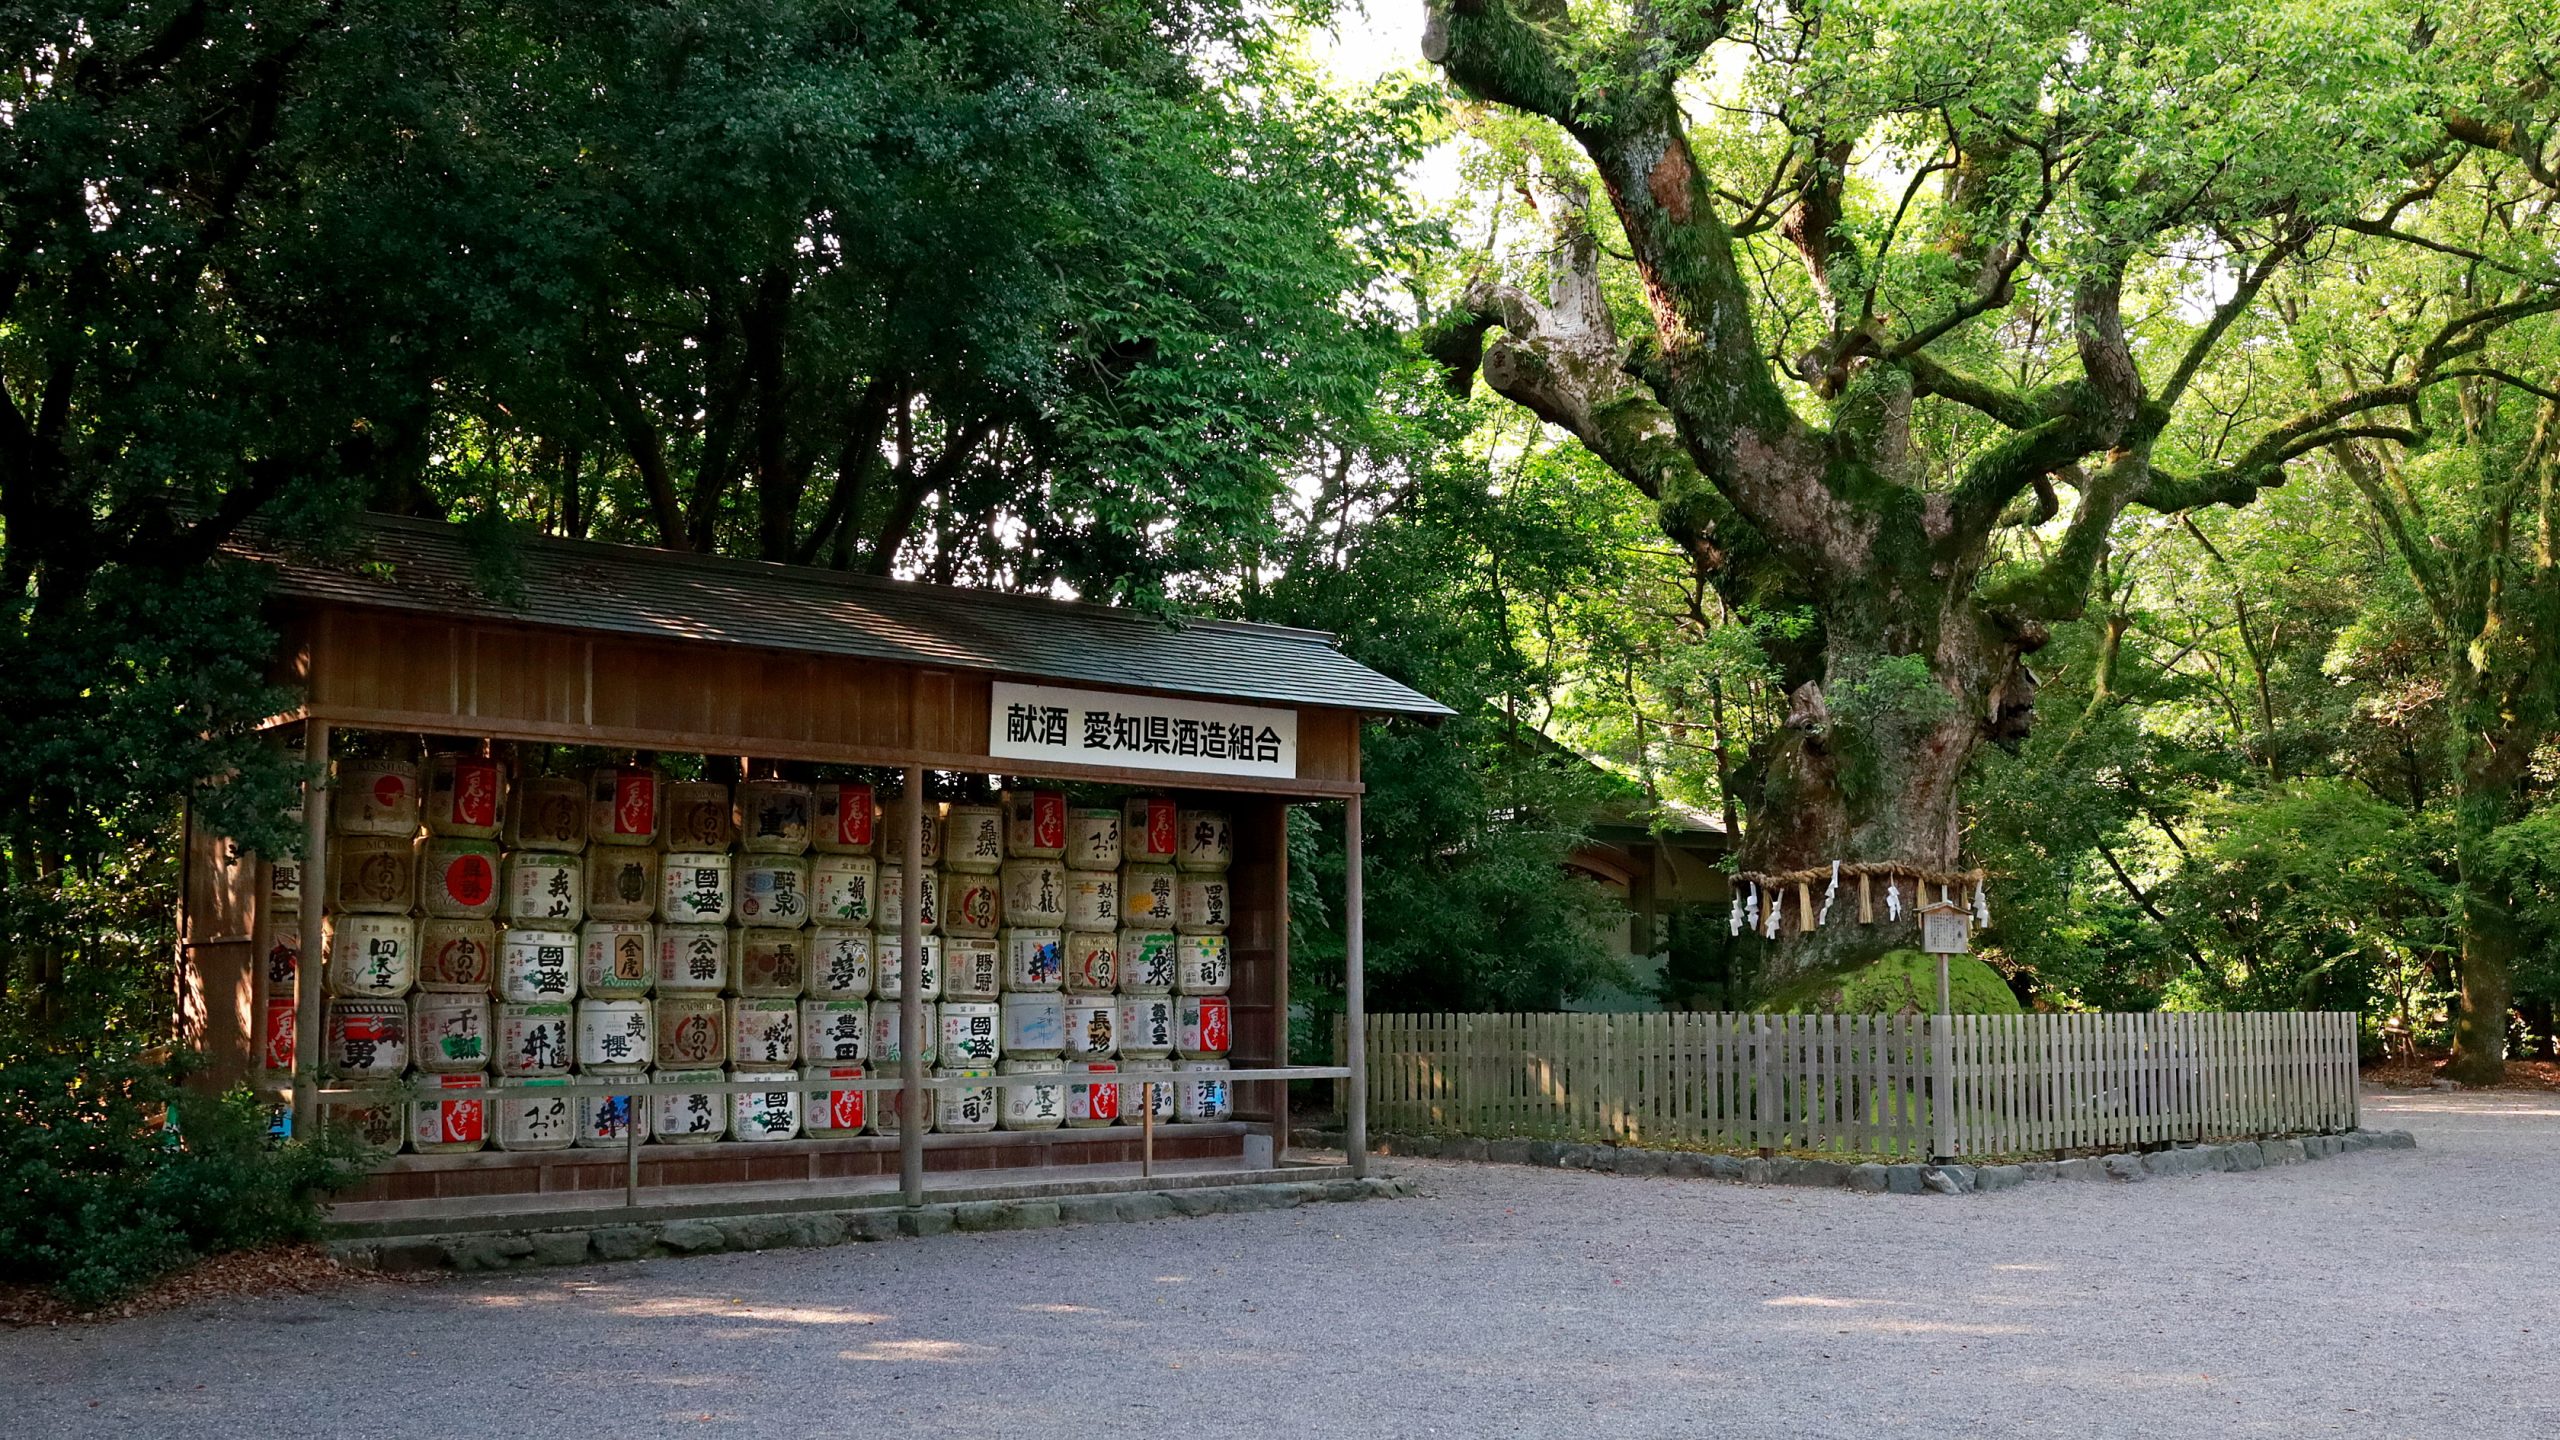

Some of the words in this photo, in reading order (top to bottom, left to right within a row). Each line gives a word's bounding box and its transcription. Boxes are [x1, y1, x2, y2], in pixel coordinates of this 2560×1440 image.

[1007, 703, 1069, 747] 献酒
[1083, 710, 1282, 764] 愛知県酒造組合
[703, 801, 718, 846] ねのひ
[978, 886, 993, 929] ねのひ
[456, 936, 476, 985] ねのひ
[538, 946, 565, 994] 國盛
[620, 938, 642, 978] 金虎
[1098, 946, 1111, 989] ねのひ
[691, 1013, 708, 1061] ねのひ
[970, 1016, 995, 1059] 國盛
[1197, 1080, 1217, 1118] 清酒
